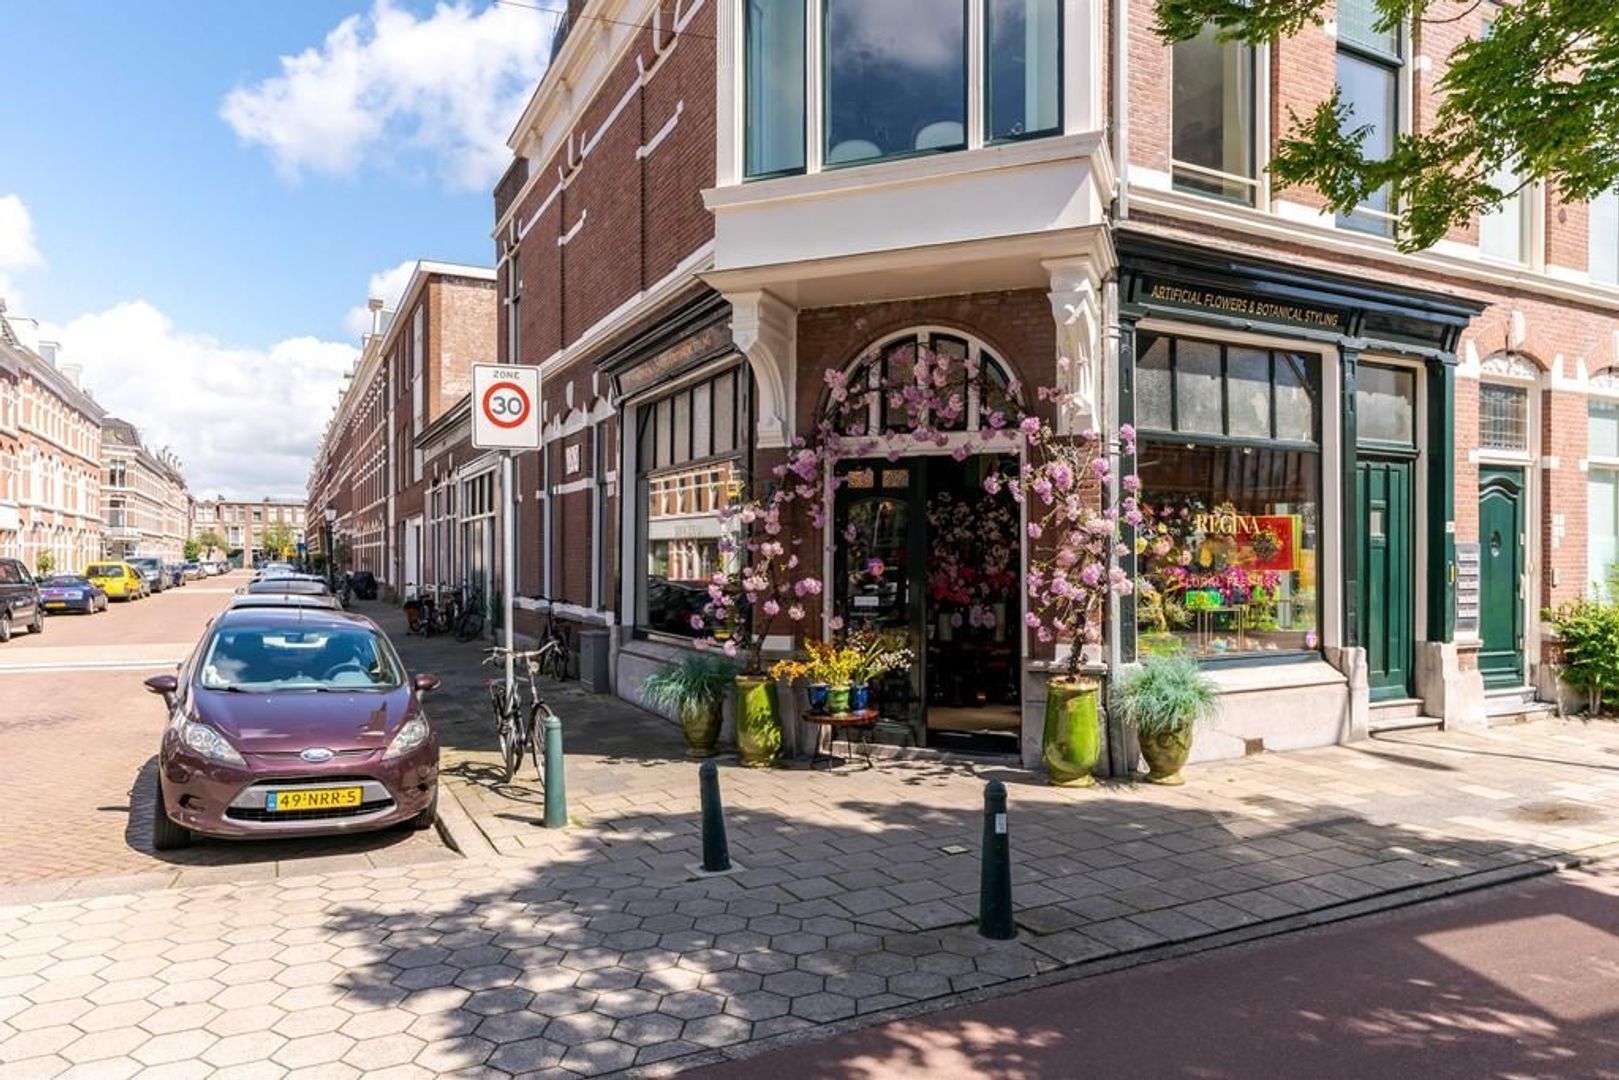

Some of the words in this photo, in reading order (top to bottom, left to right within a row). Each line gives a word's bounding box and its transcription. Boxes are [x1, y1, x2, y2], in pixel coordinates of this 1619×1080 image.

[1151, 284, 1202, 305] ARTIFICIAL
[1204, 293, 1247, 313] FLOWERS
[1248, 300, 1255, 314] &
[1256, 302, 1303, 321] BOTANICAL
[1304, 310, 1339, 327] STYLING
[493, 370, 520, 380] ZONE
[492, 396, 523, 416] 30
[1195, 512, 1261, 536] REGINA
